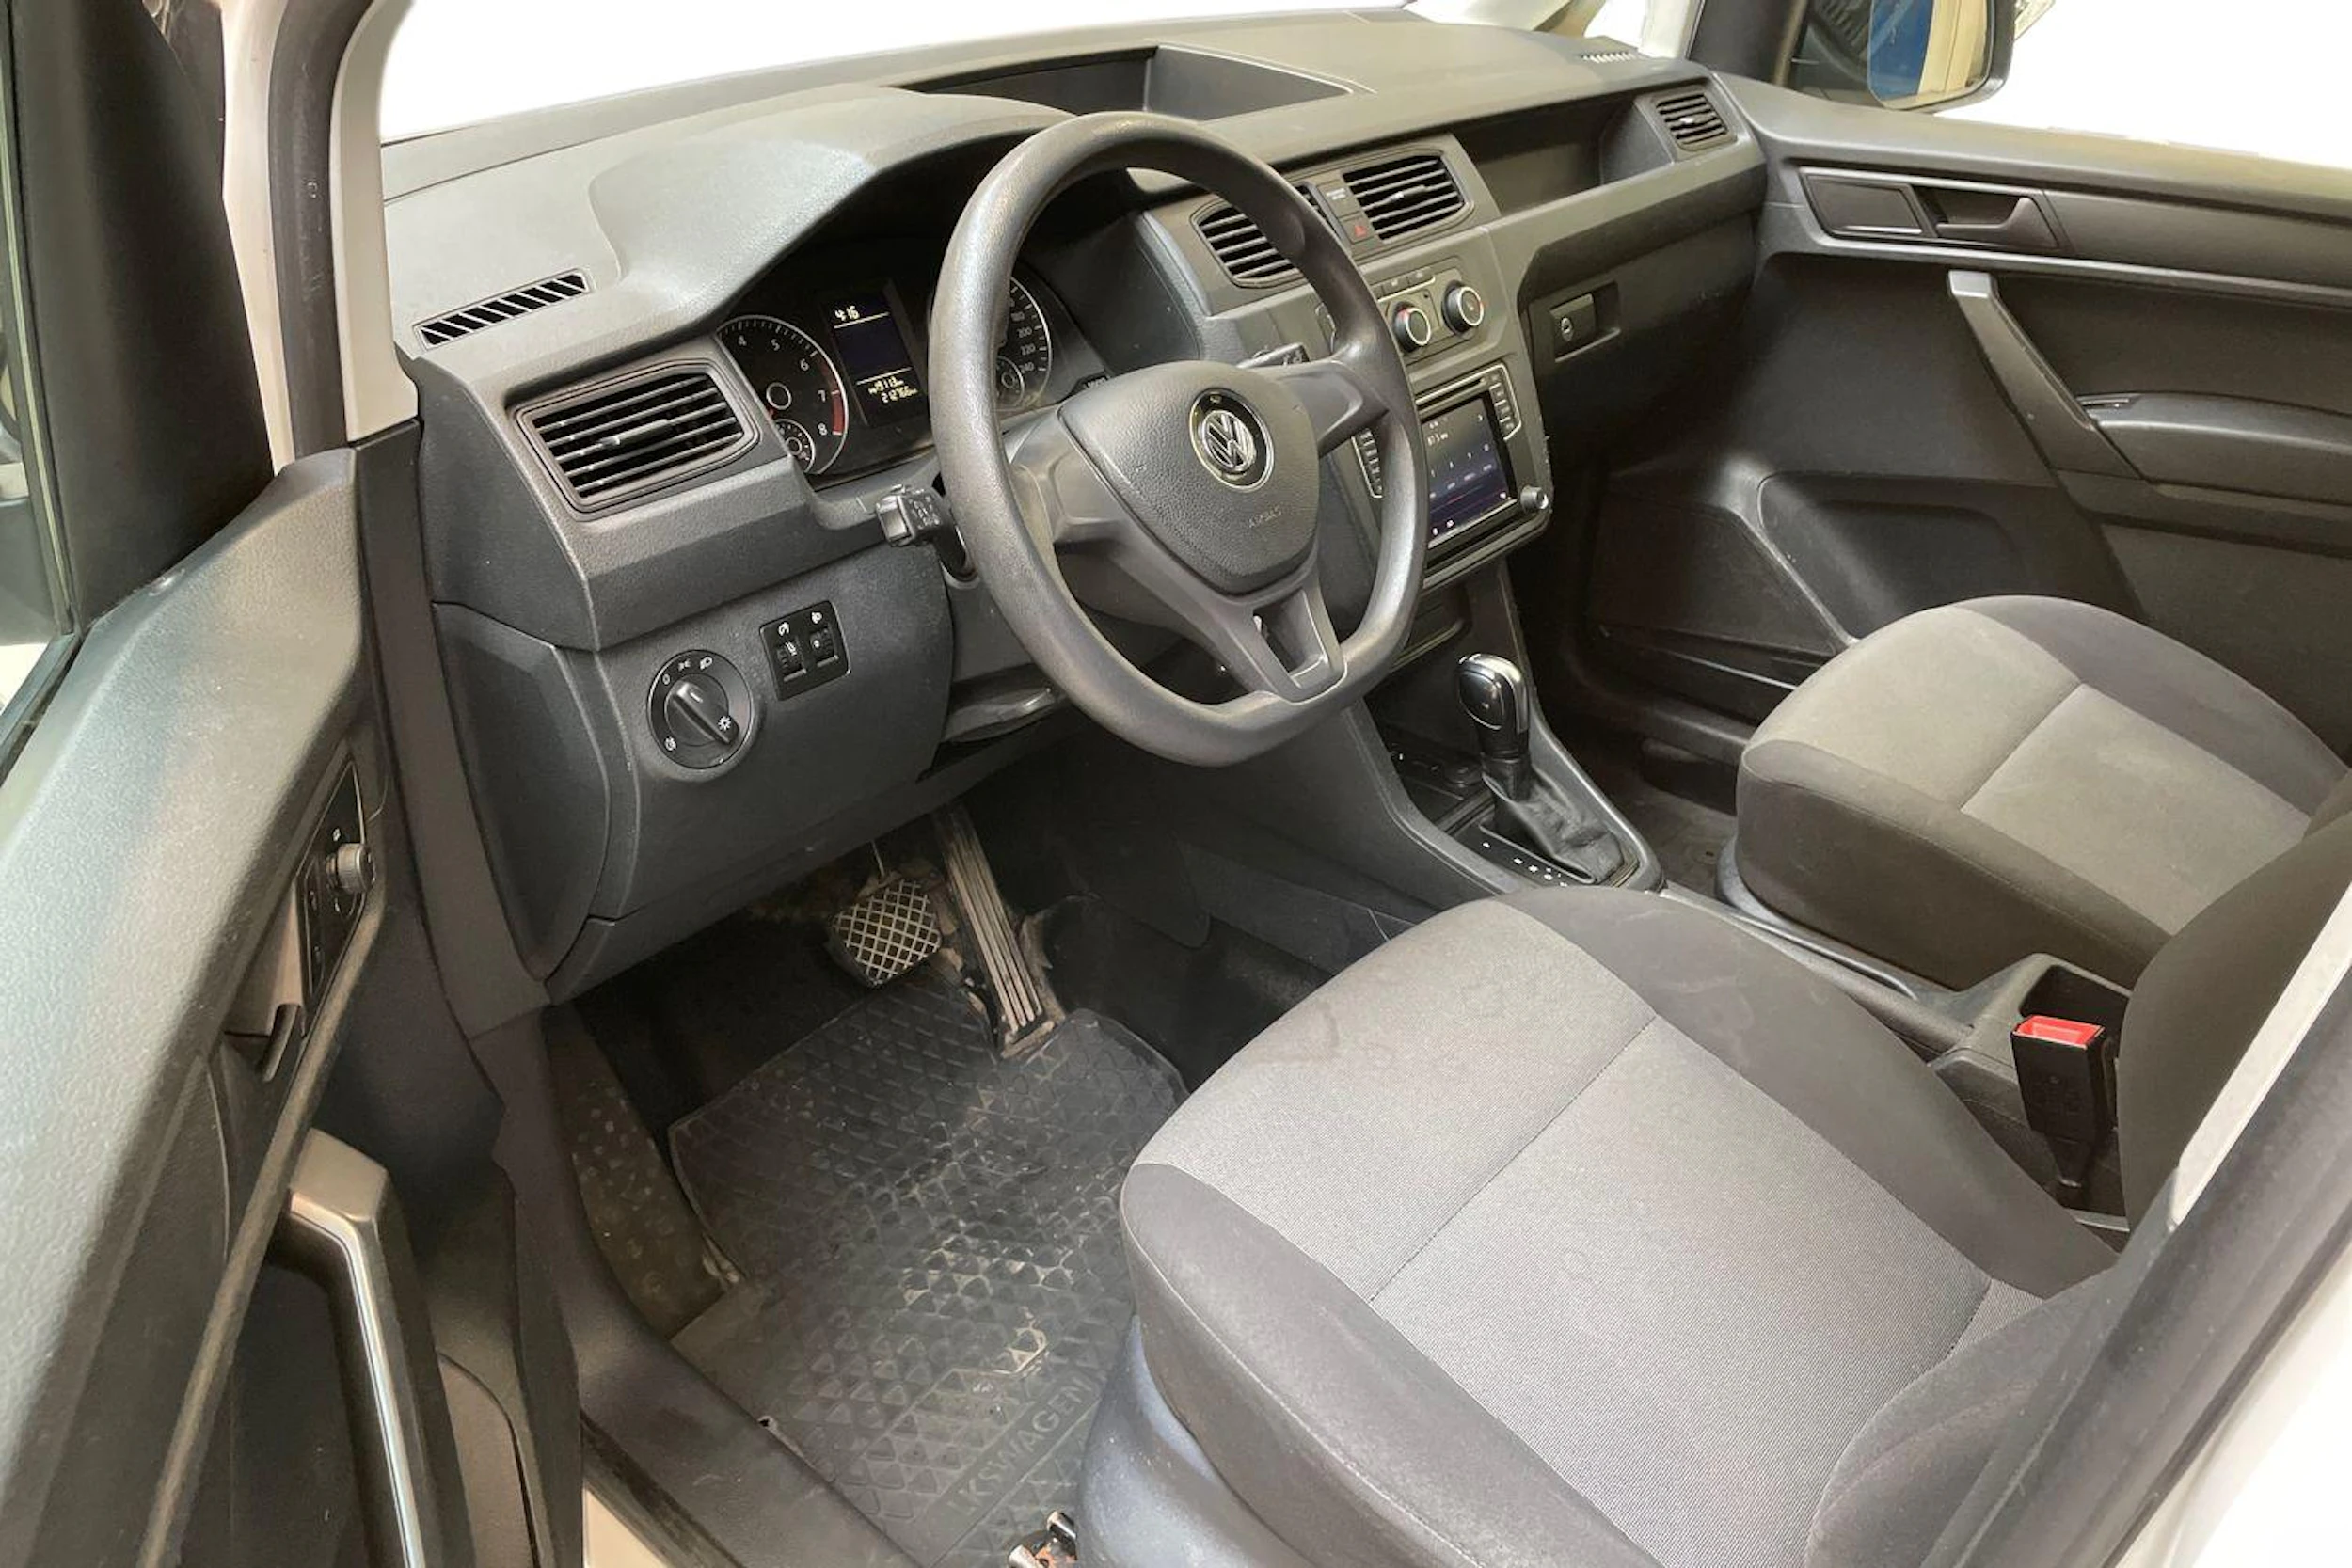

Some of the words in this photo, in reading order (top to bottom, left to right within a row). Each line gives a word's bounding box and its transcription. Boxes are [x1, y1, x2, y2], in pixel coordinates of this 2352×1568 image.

[738, 335, 747, 346] 4
[771, 339, 781, 351] 5
[800, 358, 809, 372] 6
[818, 389, 826, 403] 7
[818, 423, 828, 436] 8
